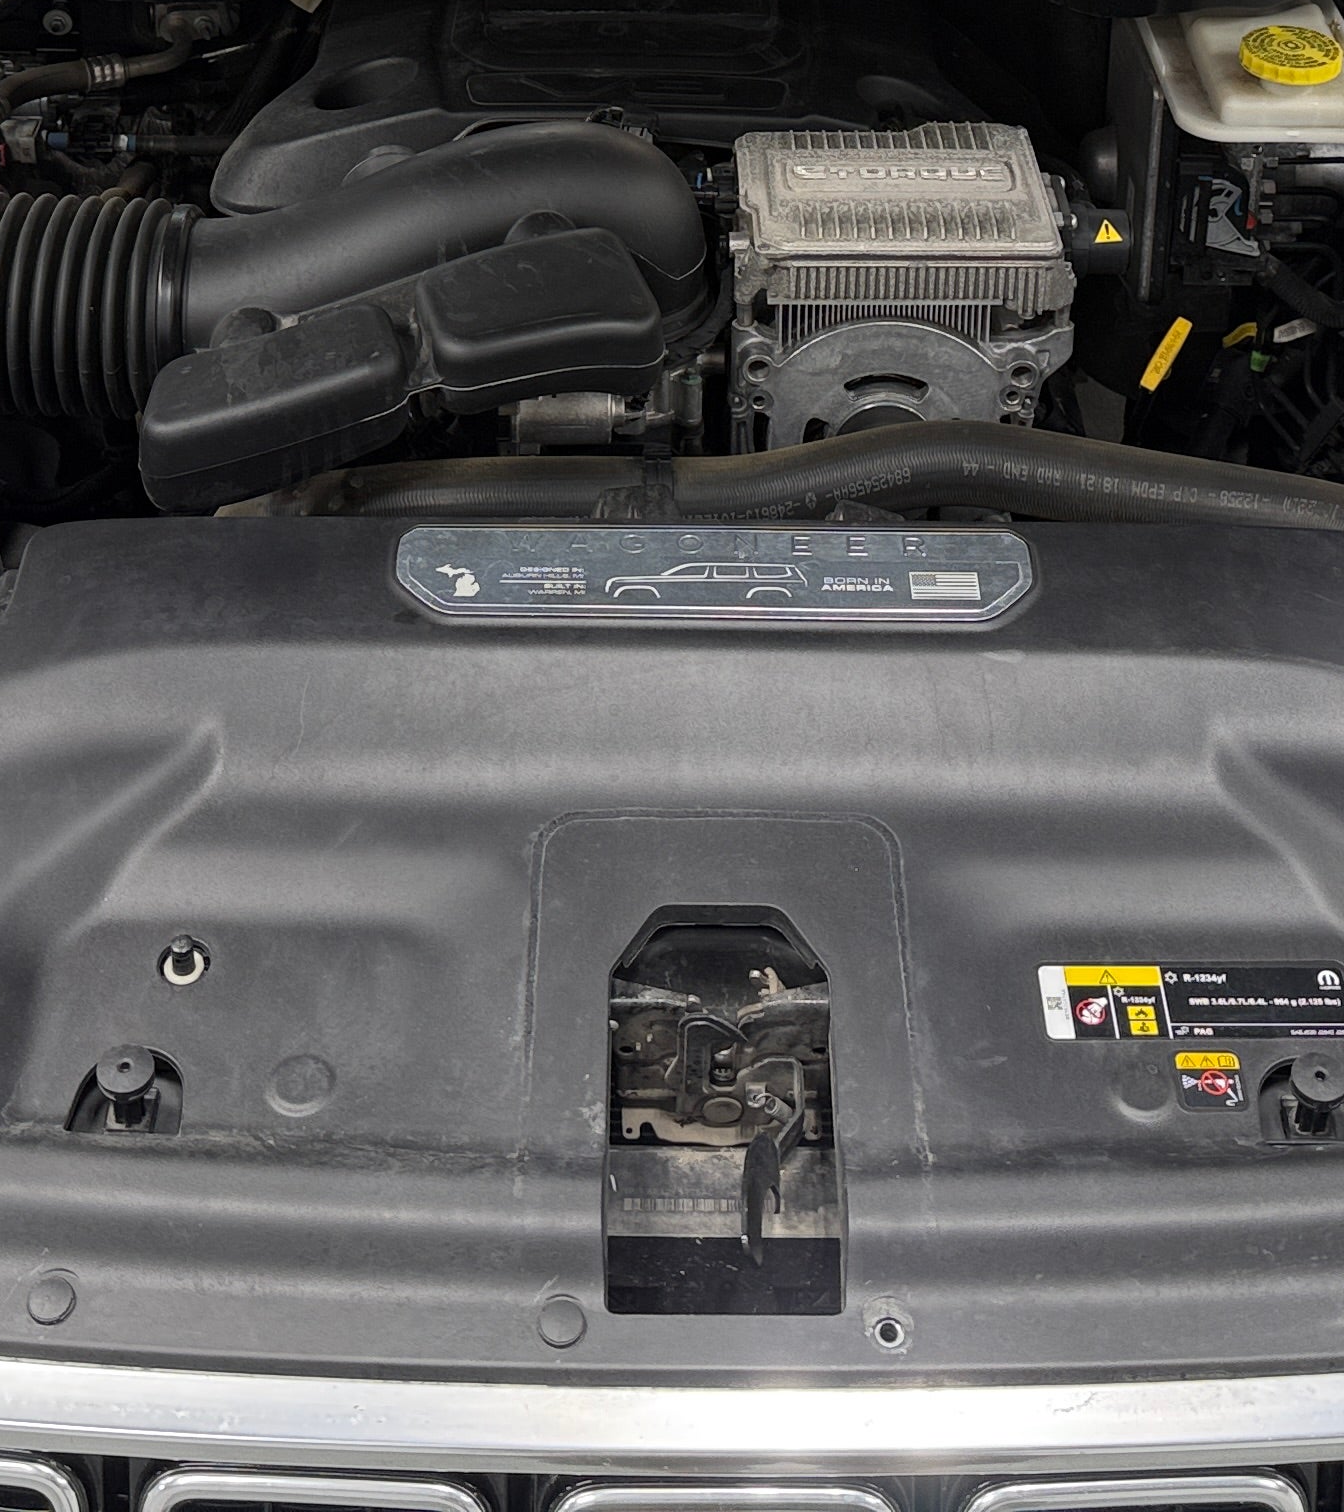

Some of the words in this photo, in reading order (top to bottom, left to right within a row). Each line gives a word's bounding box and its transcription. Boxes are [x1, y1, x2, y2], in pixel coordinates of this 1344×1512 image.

[1131, 479, 1165, 500] EPDM
[511, 534, 927, 558] WAGONEER
[823, 576, 869, 585] BORN
[874, 576, 890, 585] IN
[821, 584, 894, 592] AMERICA
[1182, 972, 1227, 985] R-1234yf
